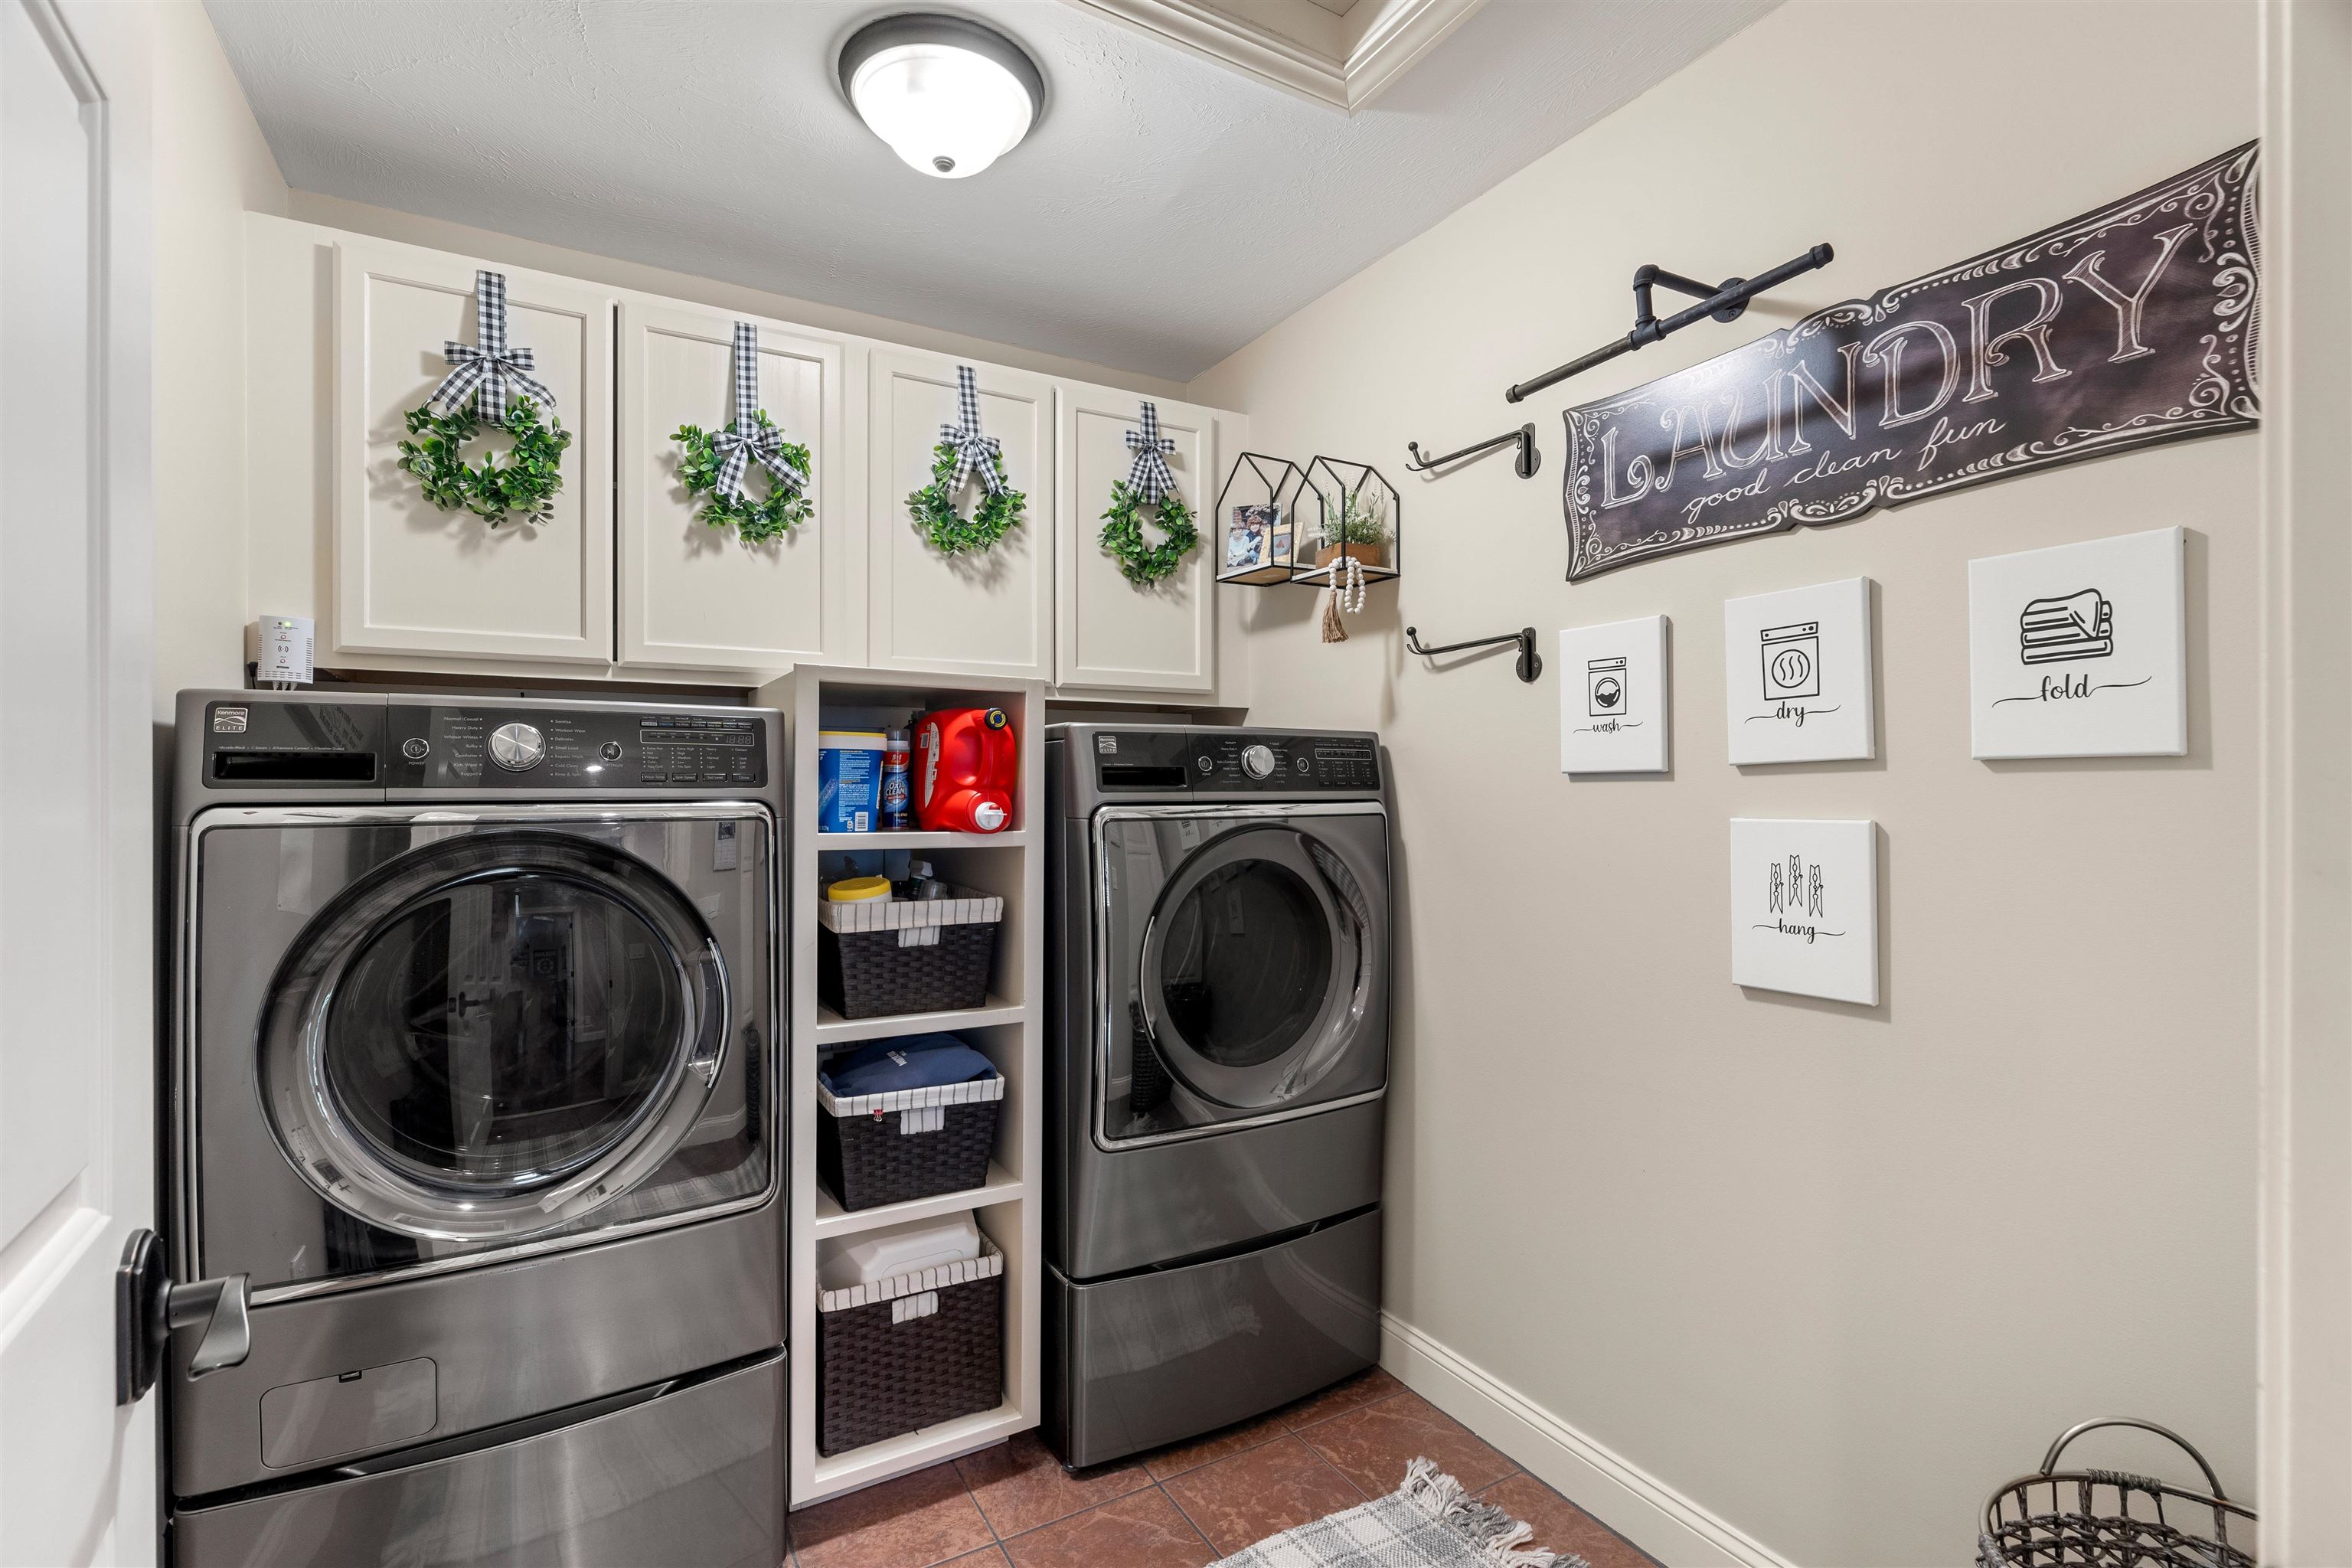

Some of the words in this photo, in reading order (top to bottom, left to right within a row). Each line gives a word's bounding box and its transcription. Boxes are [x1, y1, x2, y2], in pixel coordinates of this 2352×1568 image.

[1601, 223, 2199, 511] LAUNDRY
[1681, 467, 1772, 524] good
[1782, 449, 1903, 488] clean
[1917, 416, 2007, 472] fun
[885, 786, 905, 795] CLEAN
[1778, 917, 1816, 945] hang
